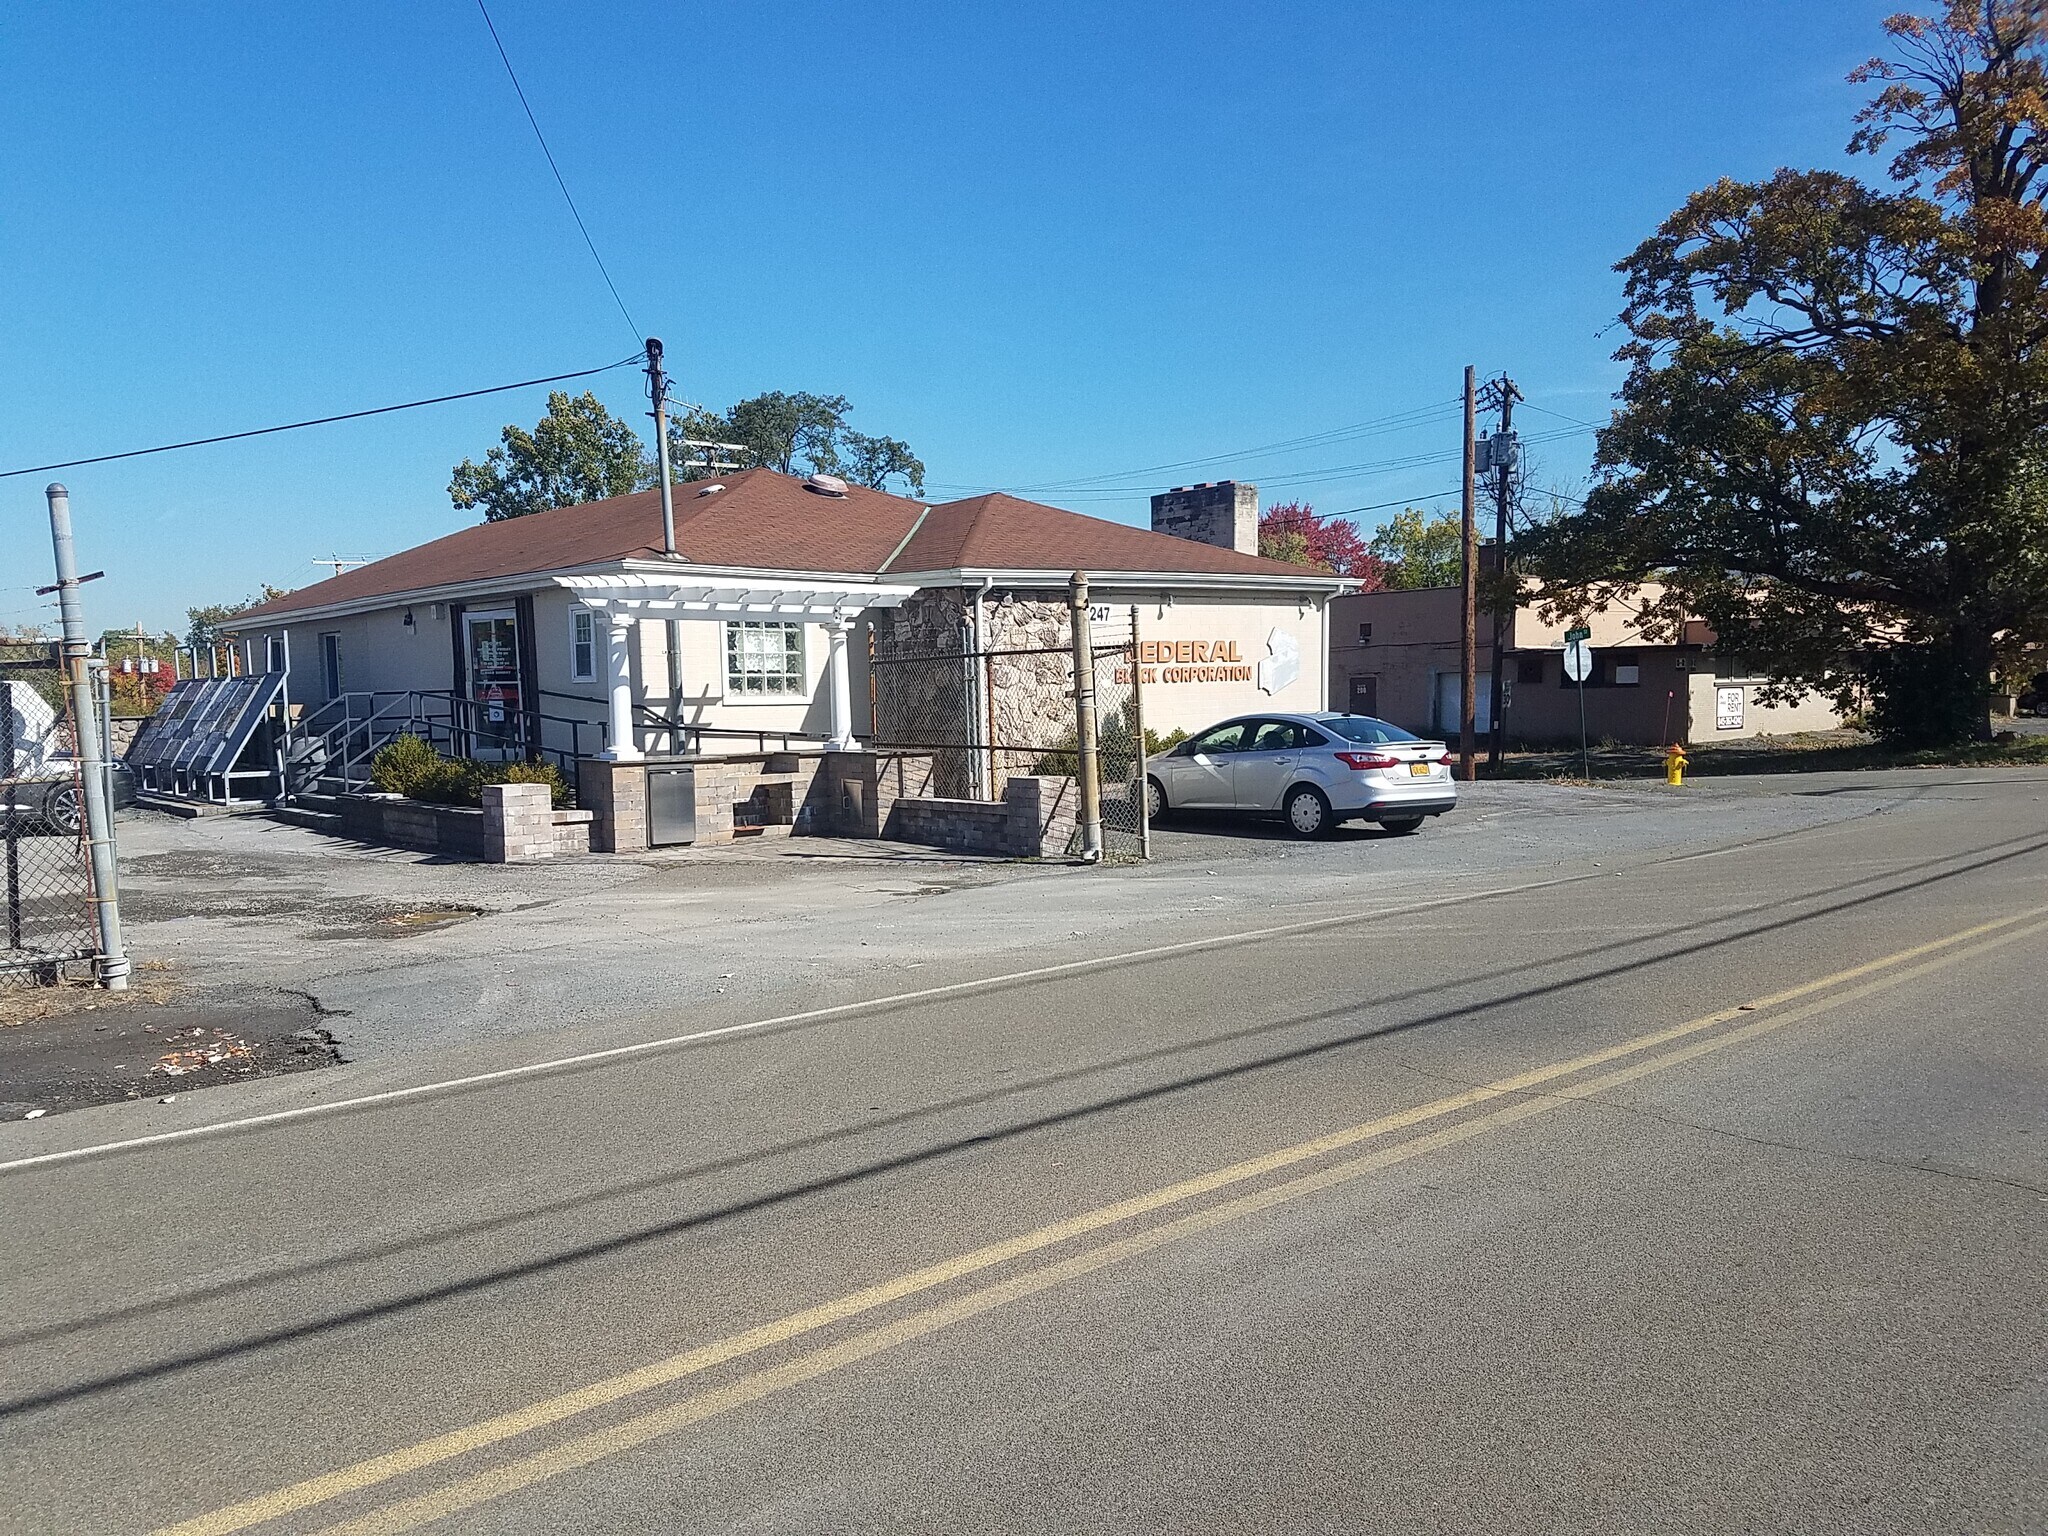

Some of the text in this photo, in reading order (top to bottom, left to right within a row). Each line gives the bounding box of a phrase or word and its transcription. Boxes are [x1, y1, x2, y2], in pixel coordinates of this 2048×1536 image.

[1090, 606, 1110, 621] 247
[1114, 665, 1252, 685] BLCK CORPORATION
[1727, 692, 1740, 702] FOR
[1727, 702, 1742, 712] RENT
